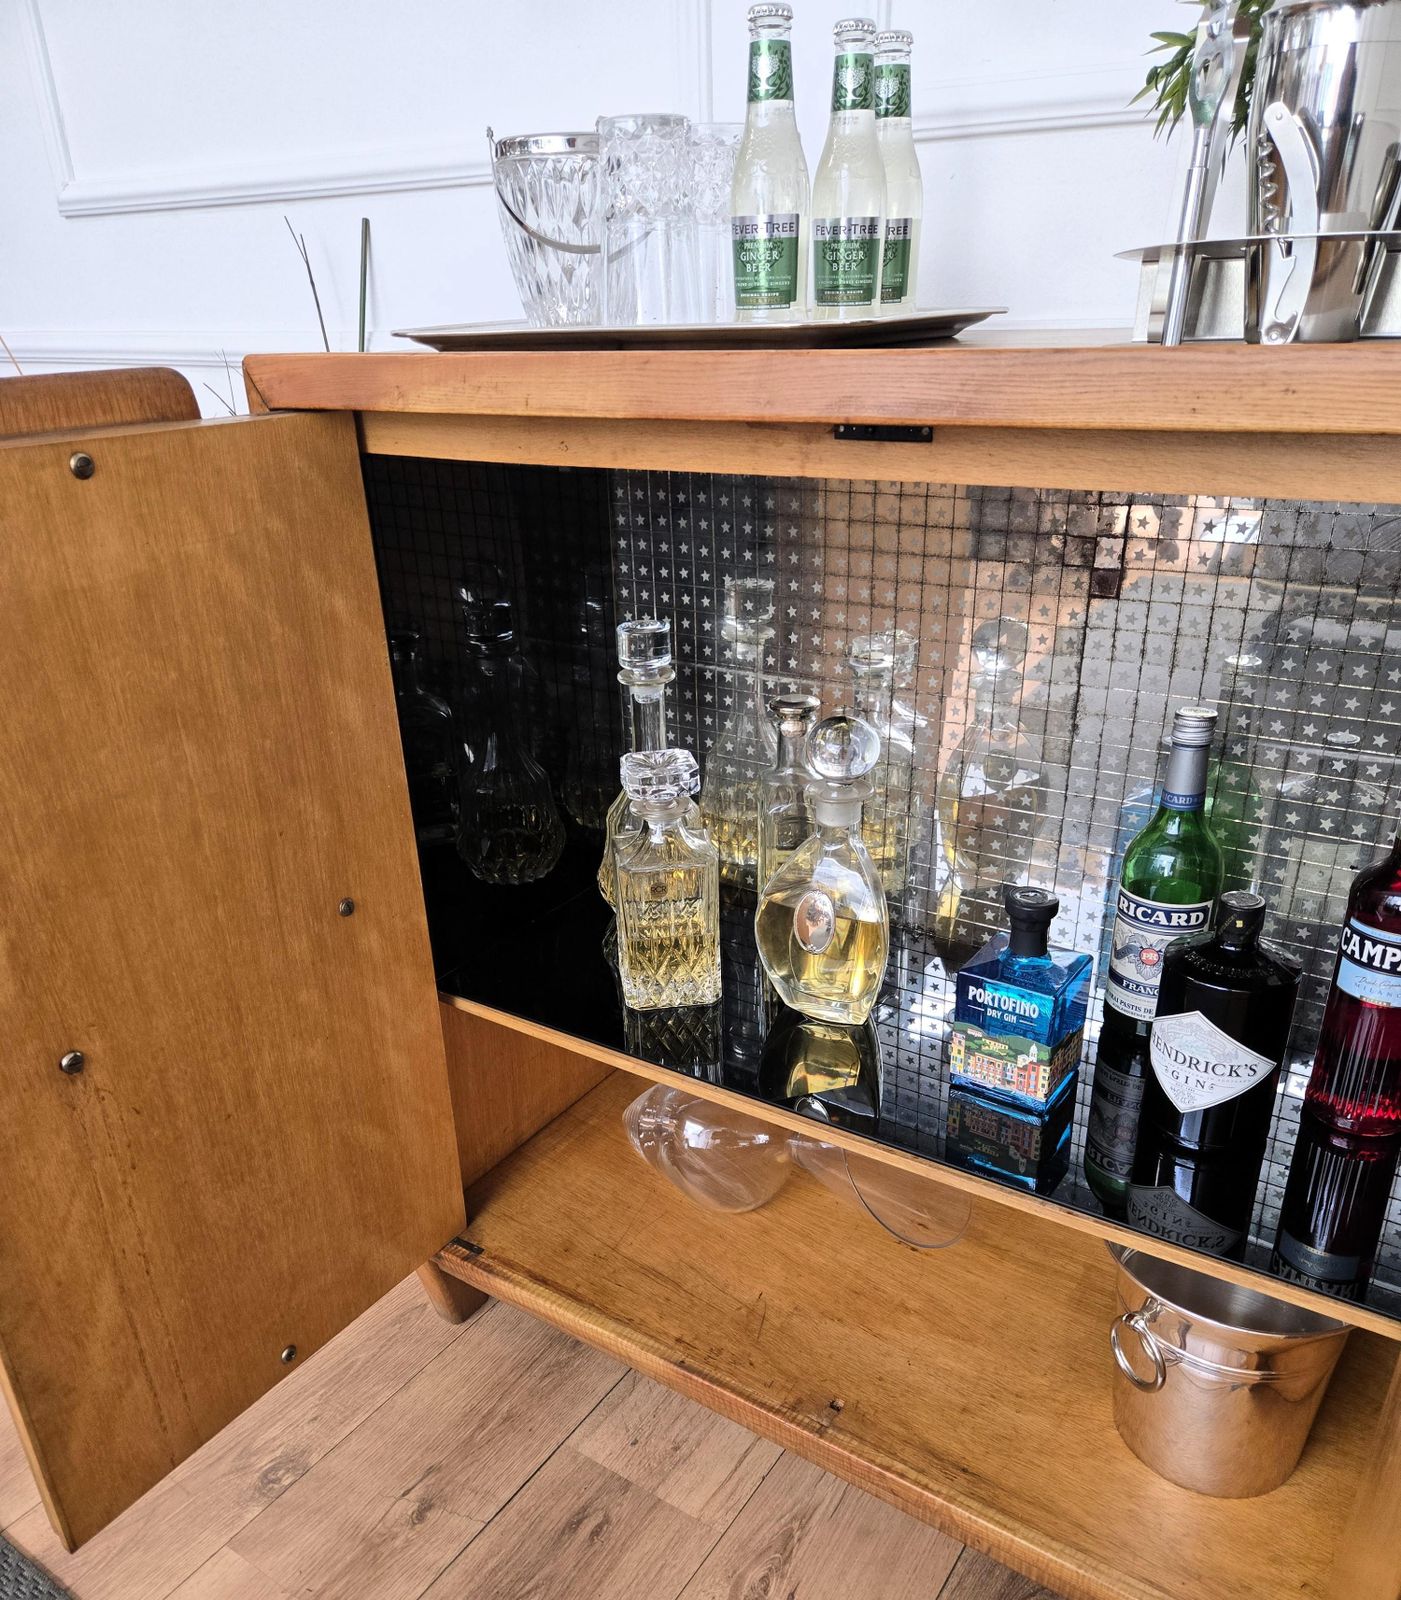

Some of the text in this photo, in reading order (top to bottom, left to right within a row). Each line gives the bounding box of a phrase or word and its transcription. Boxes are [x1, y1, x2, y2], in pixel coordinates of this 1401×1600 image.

[732, 221, 795, 235] FEVER-TREE
[816, 224, 878, 236] FEVER-TREE
[740, 250, 779, 261] GINGER
[826, 250, 865, 260] GINGER
[746, 262, 771, 272] BEER
[832, 262, 857, 271] BEER
[1118, 895, 1204, 926] RICARD
[1341, 926, 1401, 972] CAMP
[968, 986, 1039, 1019] PORTOFINO
[1119, 1000, 1142, 1012] PASTIS
[986, 1008, 1017, 1024] DRY GIN
[1171, 1070, 1206, 1090] GIN
